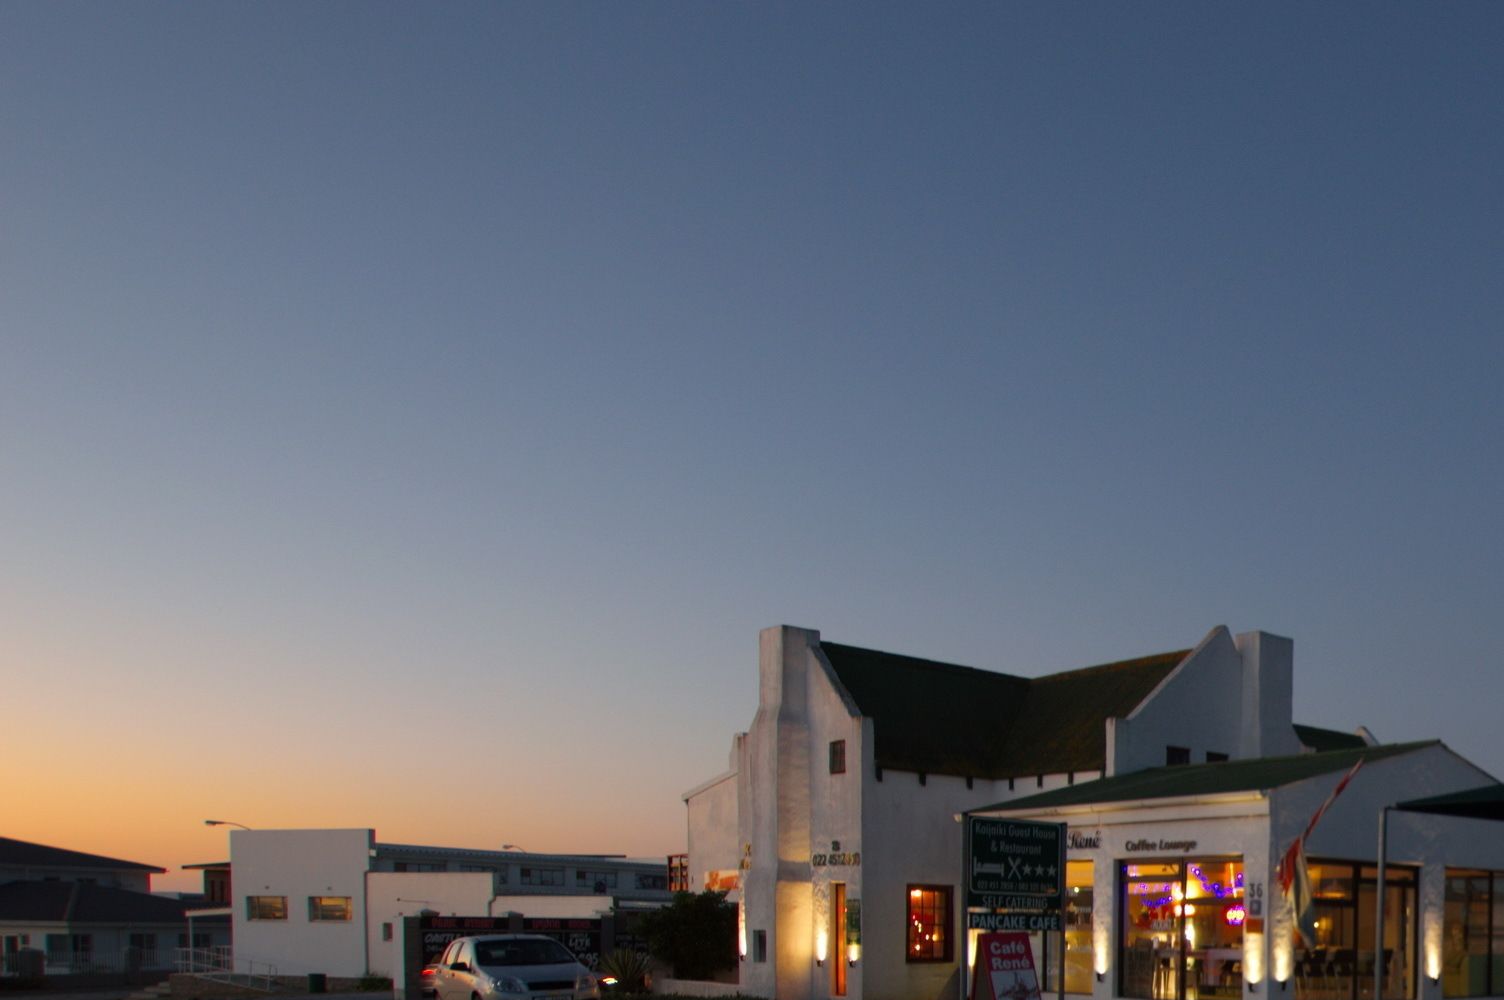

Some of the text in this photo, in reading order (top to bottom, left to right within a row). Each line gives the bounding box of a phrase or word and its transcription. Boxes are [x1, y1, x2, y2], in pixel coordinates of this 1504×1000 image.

[1008, 824, 1030, 838] Guest
[1032, 826, 1057, 841] House
[999, 840, 1042, 856] Restaurant
[1125, 839, 1197, 852] Coffee Lounge
[812, 854, 827, 866] 022
[1249, 883, 1263, 898] 36
[982, 895, 1048, 909] SELF CATERING
[972, 915, 1025, 929] PANCAKE
[990, 941, 1025, 955] Café
[992, 956, 1030, 970] René
